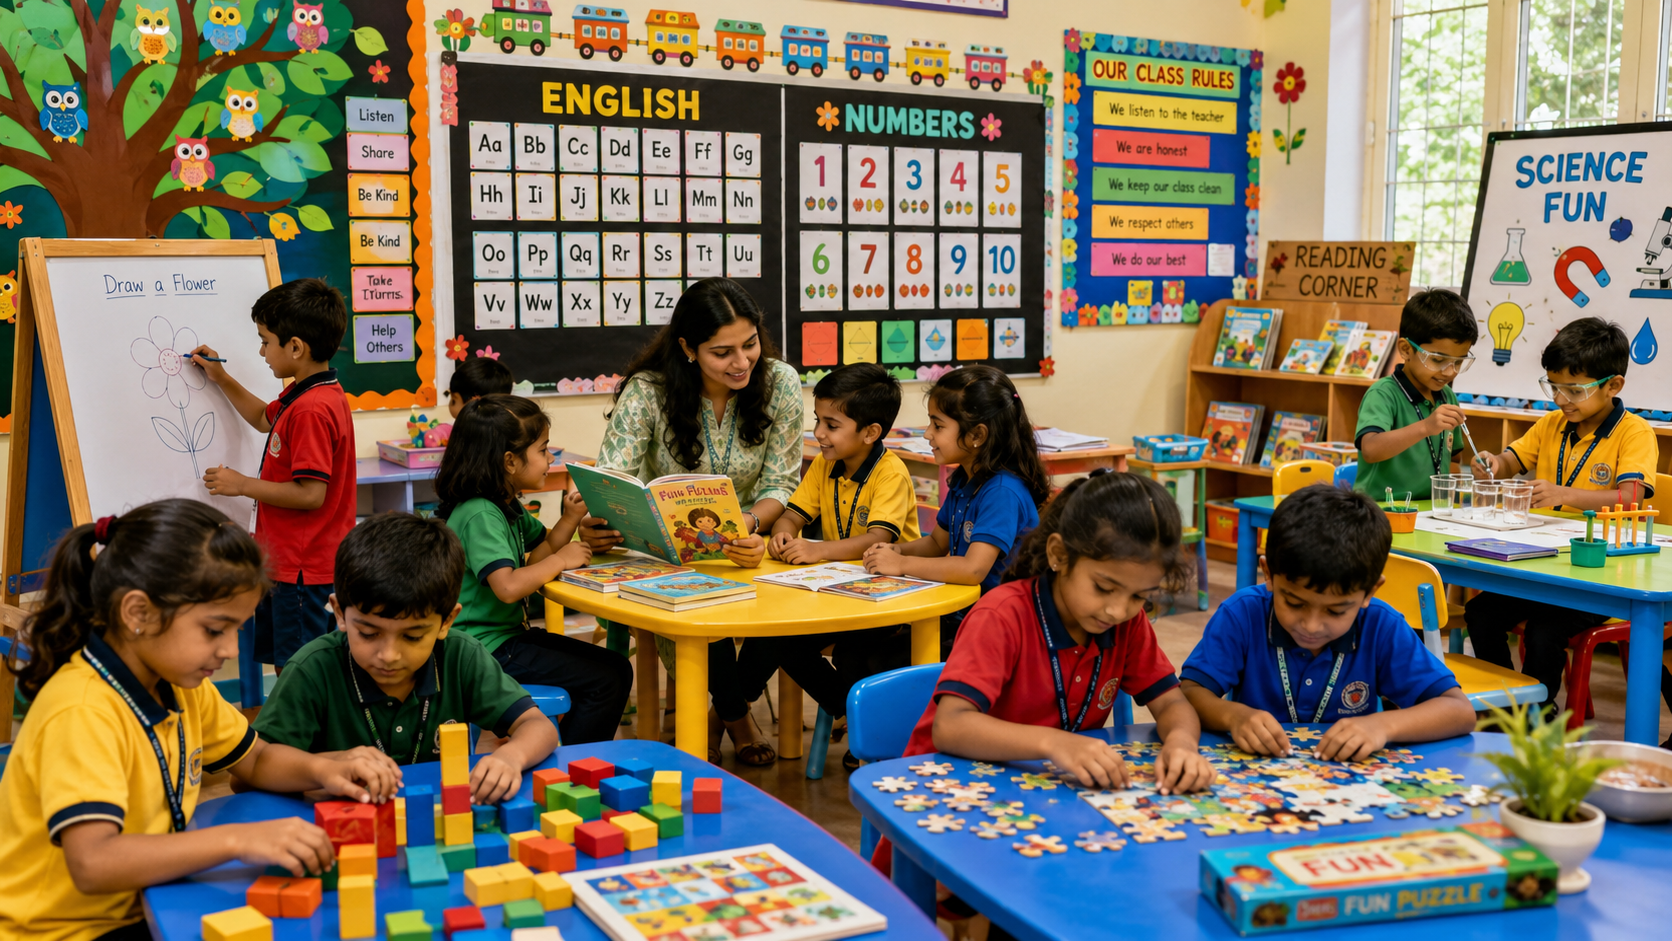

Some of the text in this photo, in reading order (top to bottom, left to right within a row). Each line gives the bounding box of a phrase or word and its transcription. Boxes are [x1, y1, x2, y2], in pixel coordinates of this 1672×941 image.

[1092, 59, 1235, 90] OUR CLASS RULES
[542, 81, 700, 121] ENGLISH
[359, 108, 394, 123] Listen
[845, 103, 975, 140] NUMBERS
[1109, 103, 1224, 123] We listen to the teacher
[361, 145, 394, 159] Share
[478, 134, 752, 165] Aa Bb Cc Dd Ee Ff Gg
[1116, 141, 1188, 157] We are honest
[813, 155, 1010, 193] 1 2 3 4 5
[1515, 151, 1648, 189] SCIENCE
[358, 188, 399, 202] Be Kind
[480, 185, 752, 209] Hh Ii Jj Kk Ll Mm Nn
[1108, 178, 1222, 195] We keep our class clean
[1544, 191, 1607, 224] FUN
[1109, 216, 1194, 232] We respect others
[360, 234, 400, 247] Be Kind
[482, 244, 752, 266] Oo Pp Qq Rr Ss Tt Uu
[812, 243, 1015, 274] 6 7 8 9 10
[1111, 253, 1186, 266] We do our best
[1295, 245, 1387, 269] READING
[103, 273, 216, 294] Draw a Flower
[366, 274, 393, 286] Take
[1298, 274, 1379, 299] CORNER
[483, 292, 673, 313] Vv Ww Xx Yy Zz
[371, 324, 397, 339] Help
[366, 341, 404, 353] Others
[1300, 853, 1395, 877] FUN
[1344, 892, 1392, 916] FUN
[1396, 882, 1485, 910] PUZZLE
